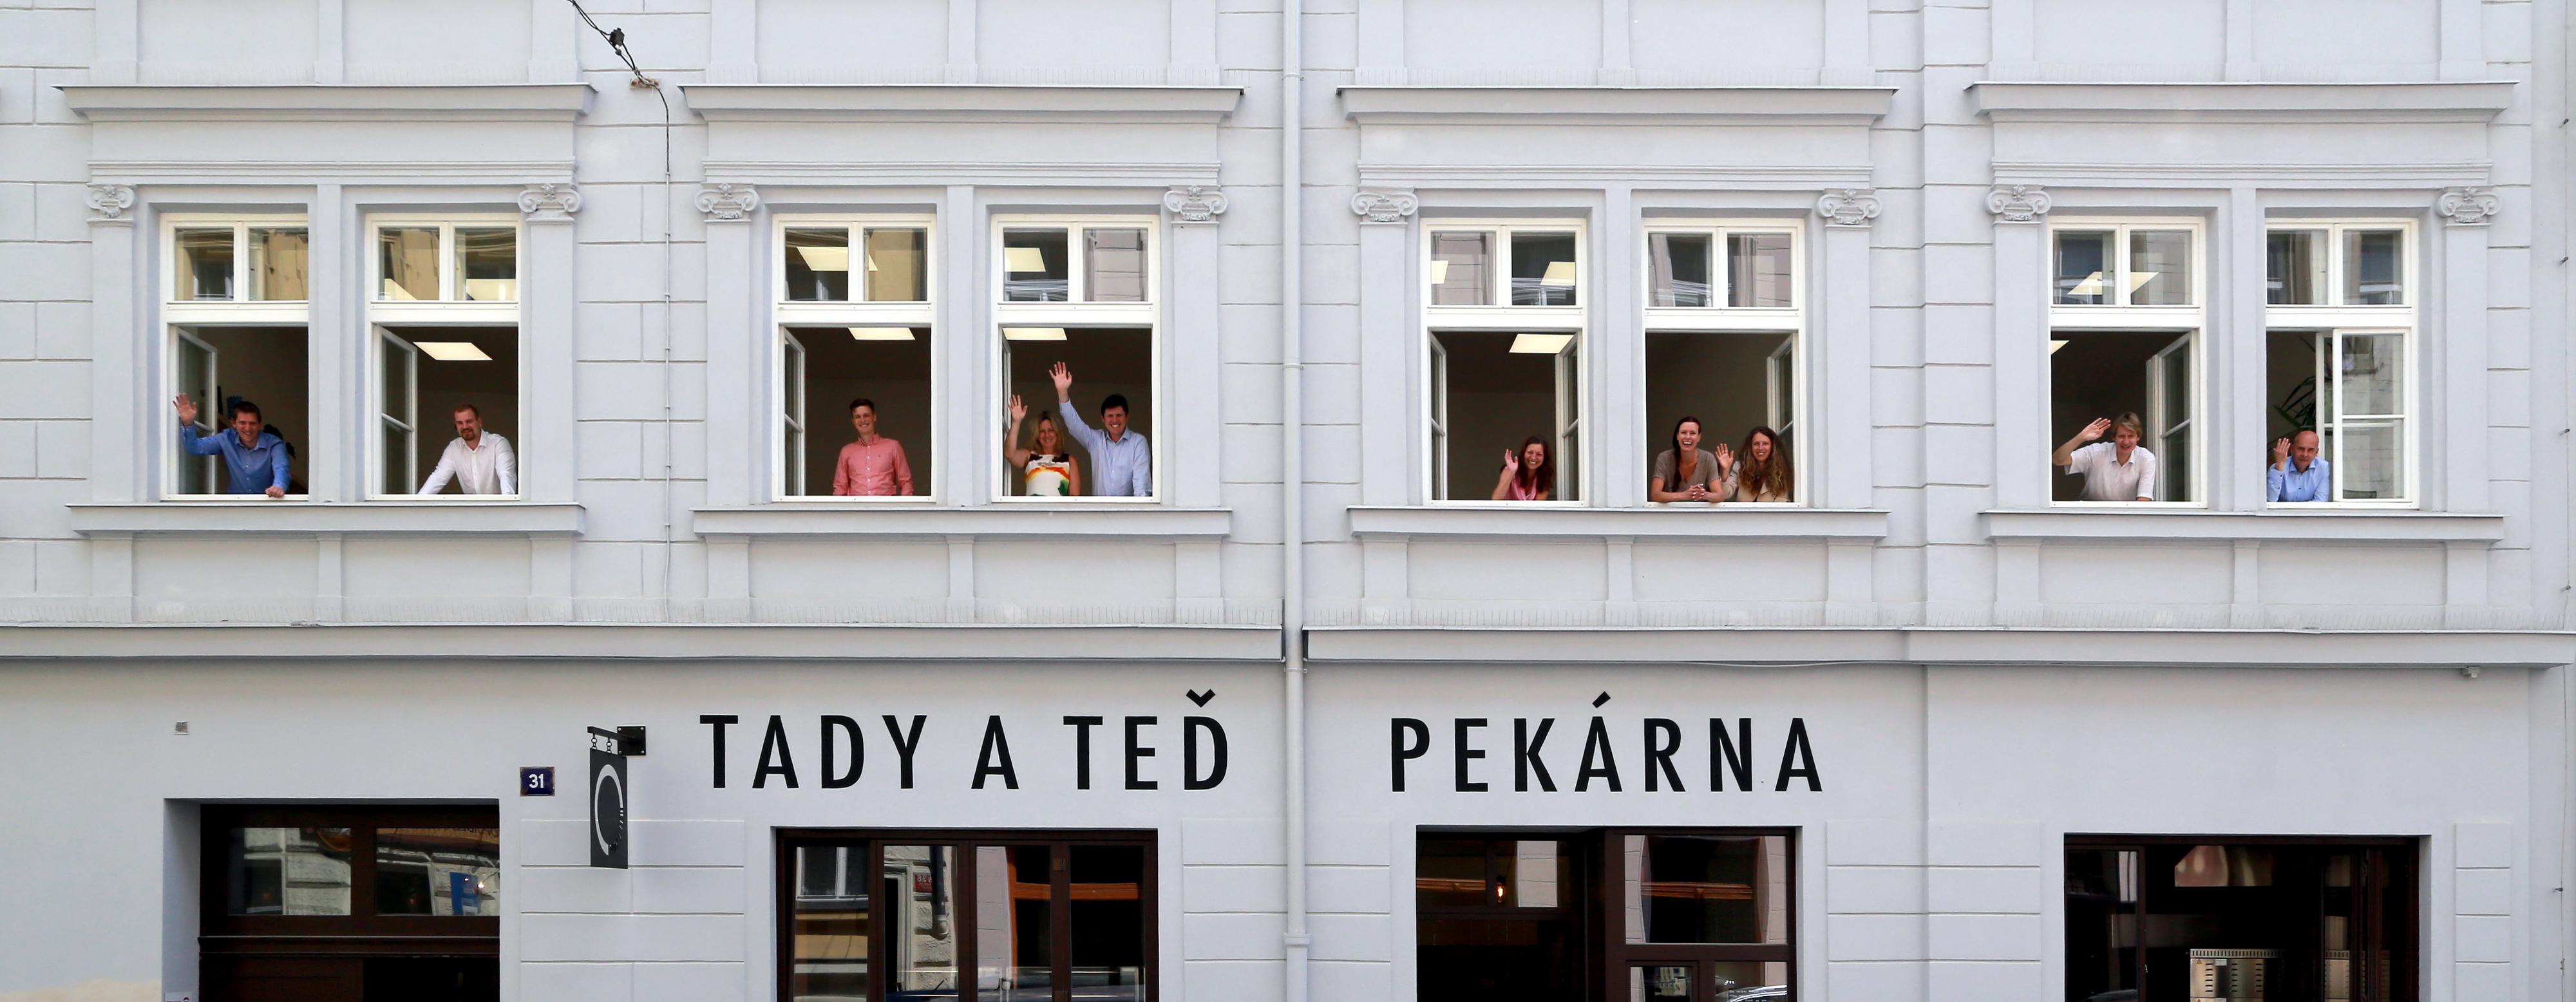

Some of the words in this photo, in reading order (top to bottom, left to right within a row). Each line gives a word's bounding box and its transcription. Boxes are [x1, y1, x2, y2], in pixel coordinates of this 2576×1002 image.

[699, 714, 927, 789] TADY
[971, 715, 1019, 789] A
[1063, 688, 1228, 791] TEĎ
[1391, 690, 1823, 792] PEKÁRNA
[528, 773, 544, 789] 31
